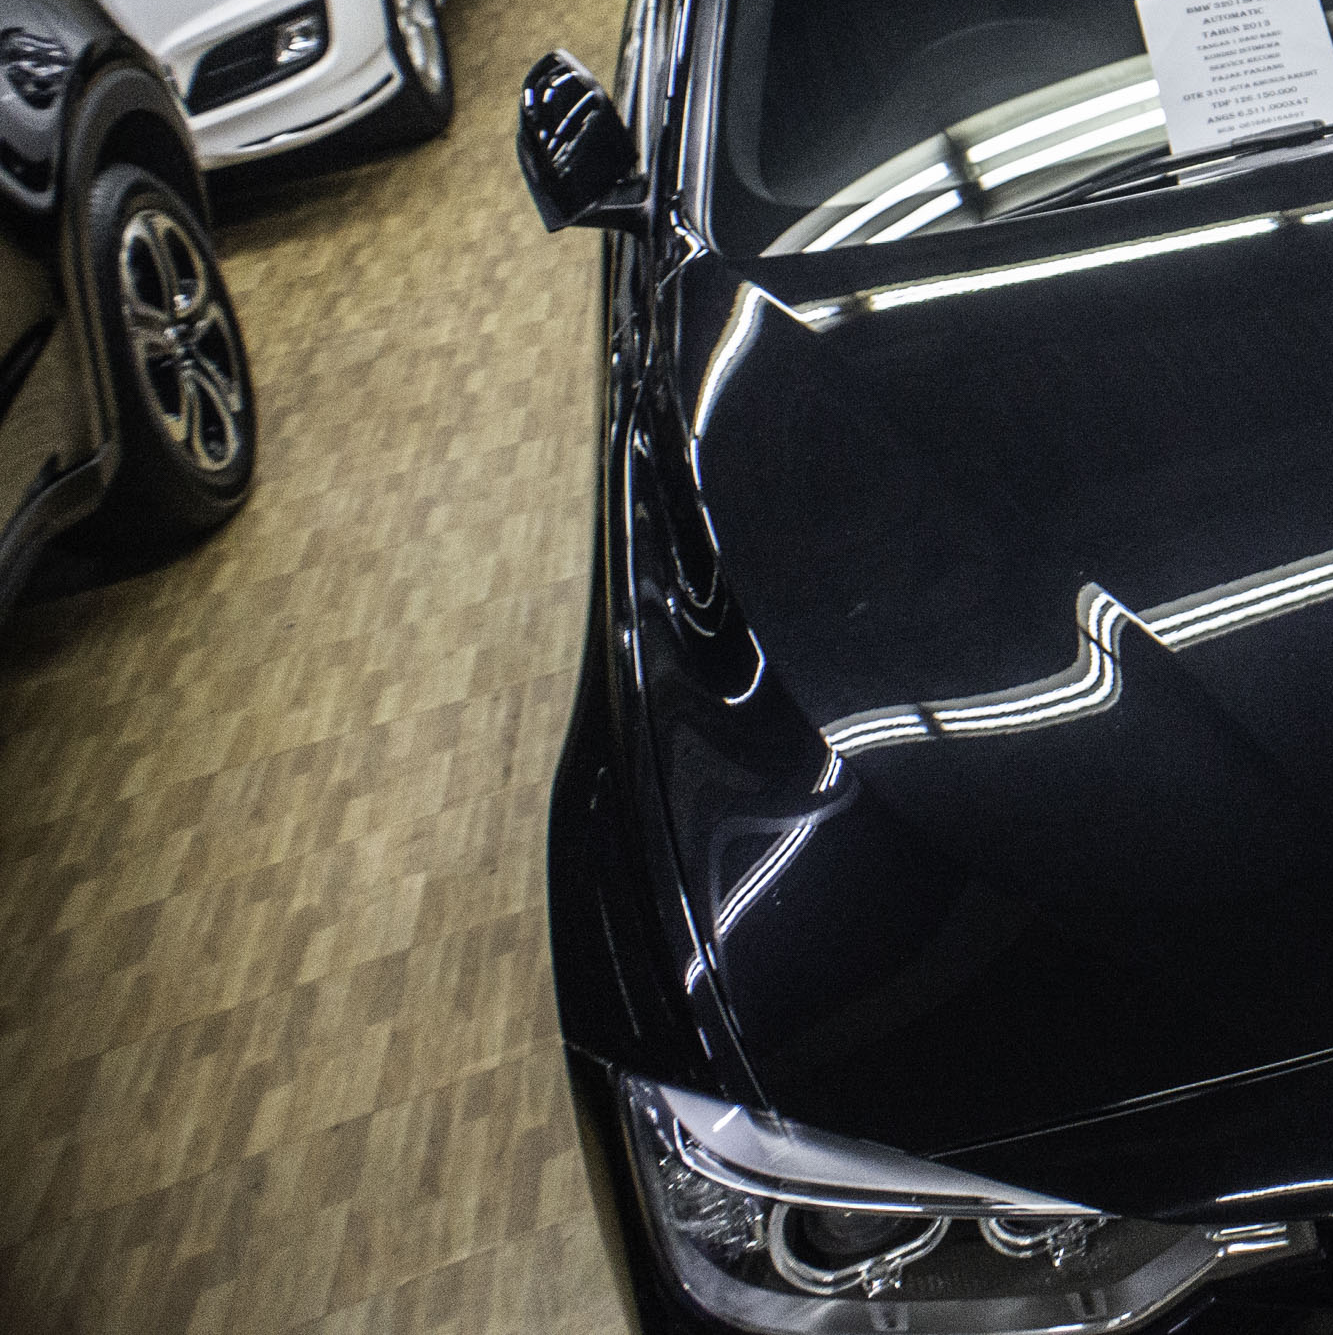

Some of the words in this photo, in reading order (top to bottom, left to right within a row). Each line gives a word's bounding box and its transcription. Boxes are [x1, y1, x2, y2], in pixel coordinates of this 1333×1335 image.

[1186, 3, 1211, 14] BMW
[1202, 6, 1264, 25] AUTOMATIC
[1202, 25, 1240, 38] TAHUN
[1243, 19, 1271, 30] 2013
